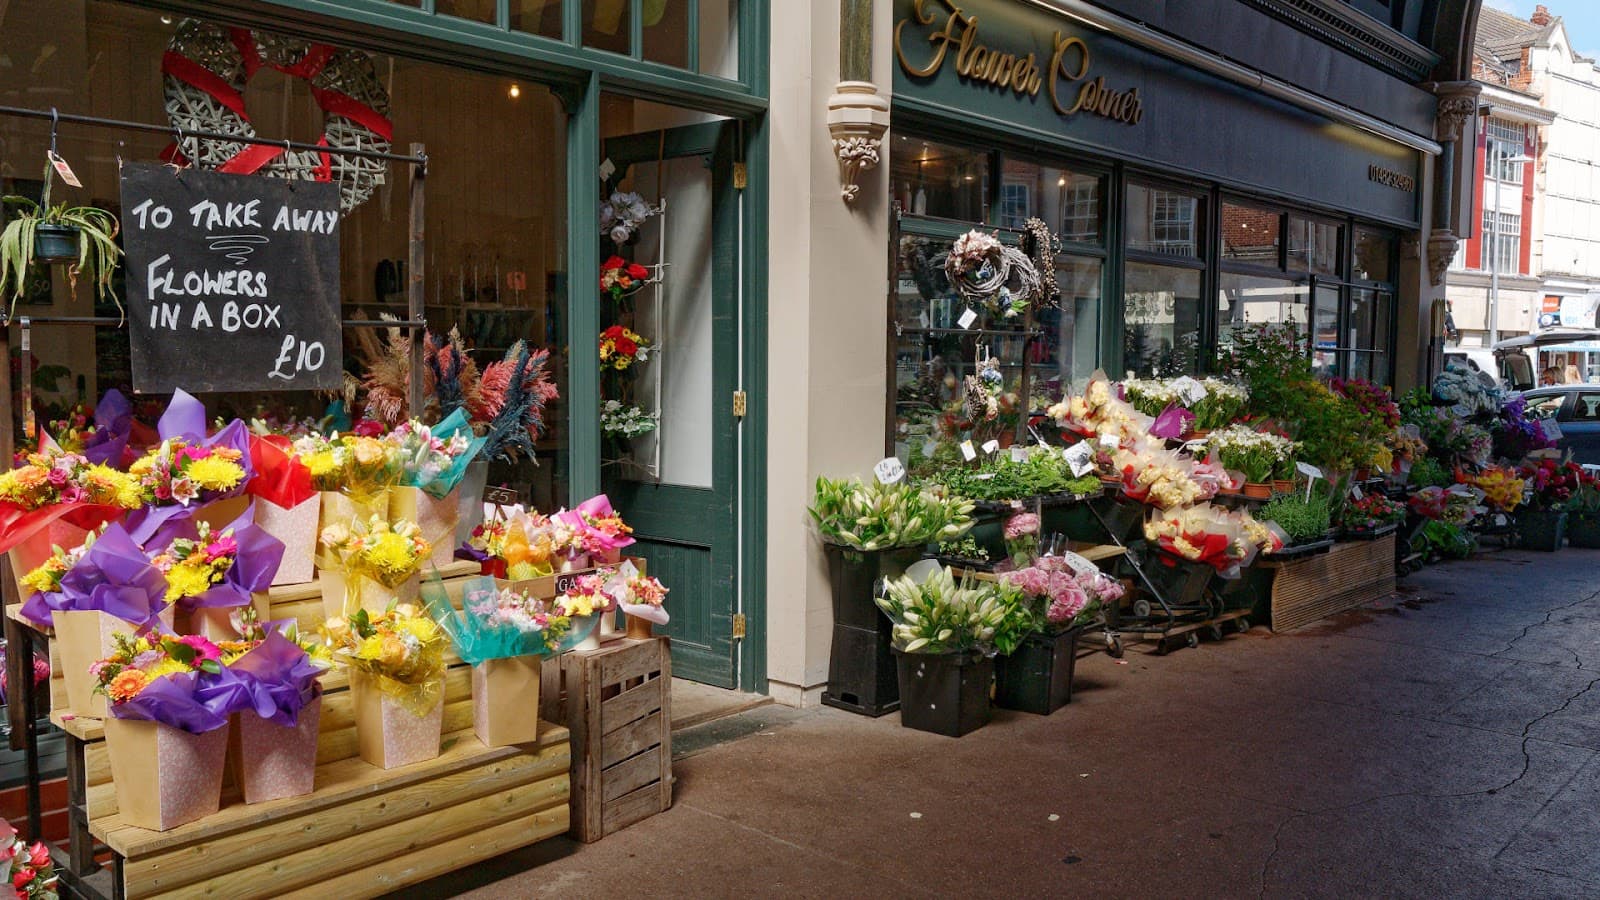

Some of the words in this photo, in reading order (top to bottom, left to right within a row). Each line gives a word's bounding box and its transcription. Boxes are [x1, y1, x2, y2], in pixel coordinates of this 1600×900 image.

[894, 0, 1042, 96] Flower
[1049, 30, 1143, 125] Corner
[132, 199, 173, 229] TO
[189, 199, 262, 231] TAKE
[272, 206, 338, 235] AWAY
[147, 254, 267, 300] FLOWERS
[150, 303, 181, 330] IN
[191, 301, 213, 330] A
[222, 301, 281, 332] BOX
[267, 335, 325, 380] £10
[487, 489, 510, 503] £5
